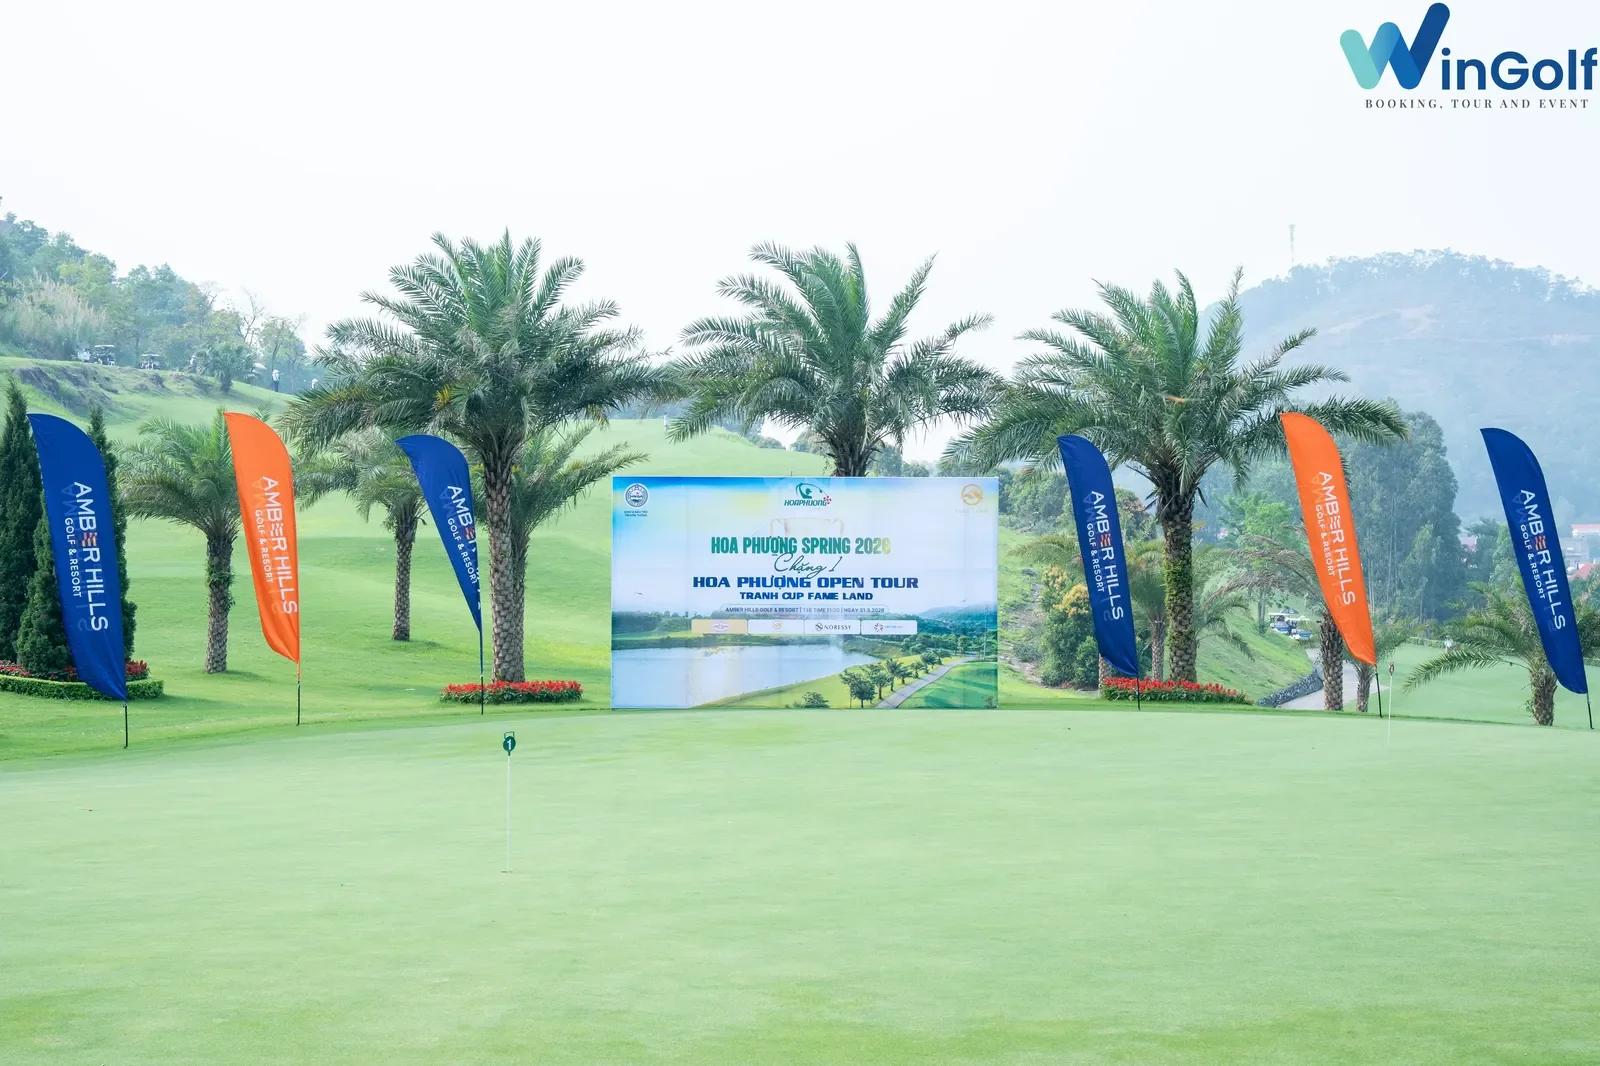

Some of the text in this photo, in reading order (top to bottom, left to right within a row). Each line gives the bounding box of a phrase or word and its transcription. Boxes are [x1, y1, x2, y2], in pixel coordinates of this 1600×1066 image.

[65, 518, 82, 597] GOLF & RESORT
[74, 481, 108, 631] AMBER HILLS
[255, 509, 273, 584] GOLF & RESORT
[262, 476, 297, 614] AMBER HILLS
[447, 518, 462, 543] GOLF
[457, 542, 465, 551] &
[711, 537, 739, 554] HOA
[801, 537, 851, 554] SPRING
[855, 537, 891, 554] 2026
[1086, 523, 1104, 593] GOLF & RESORT
[1091, 491, 1123, 620] AMBER HILLS
[1316, 505, 1335, 576] GOLF & RESORT
[1319, 471, 1355, 605] AMBER HILLS
[1520, 524, 1545, 599] GOLF & RESORT
[1521, 489, 1565, 630] AMBER HILLS
[692, 577, 731, 588] HOA
[817, 577, 865, 588] OPEN
[870, 577, 919, 588] TOUR
[740, 592, 874, 600] TRANH CUP FAME LAND
[507, 738, 512, 750] 1
